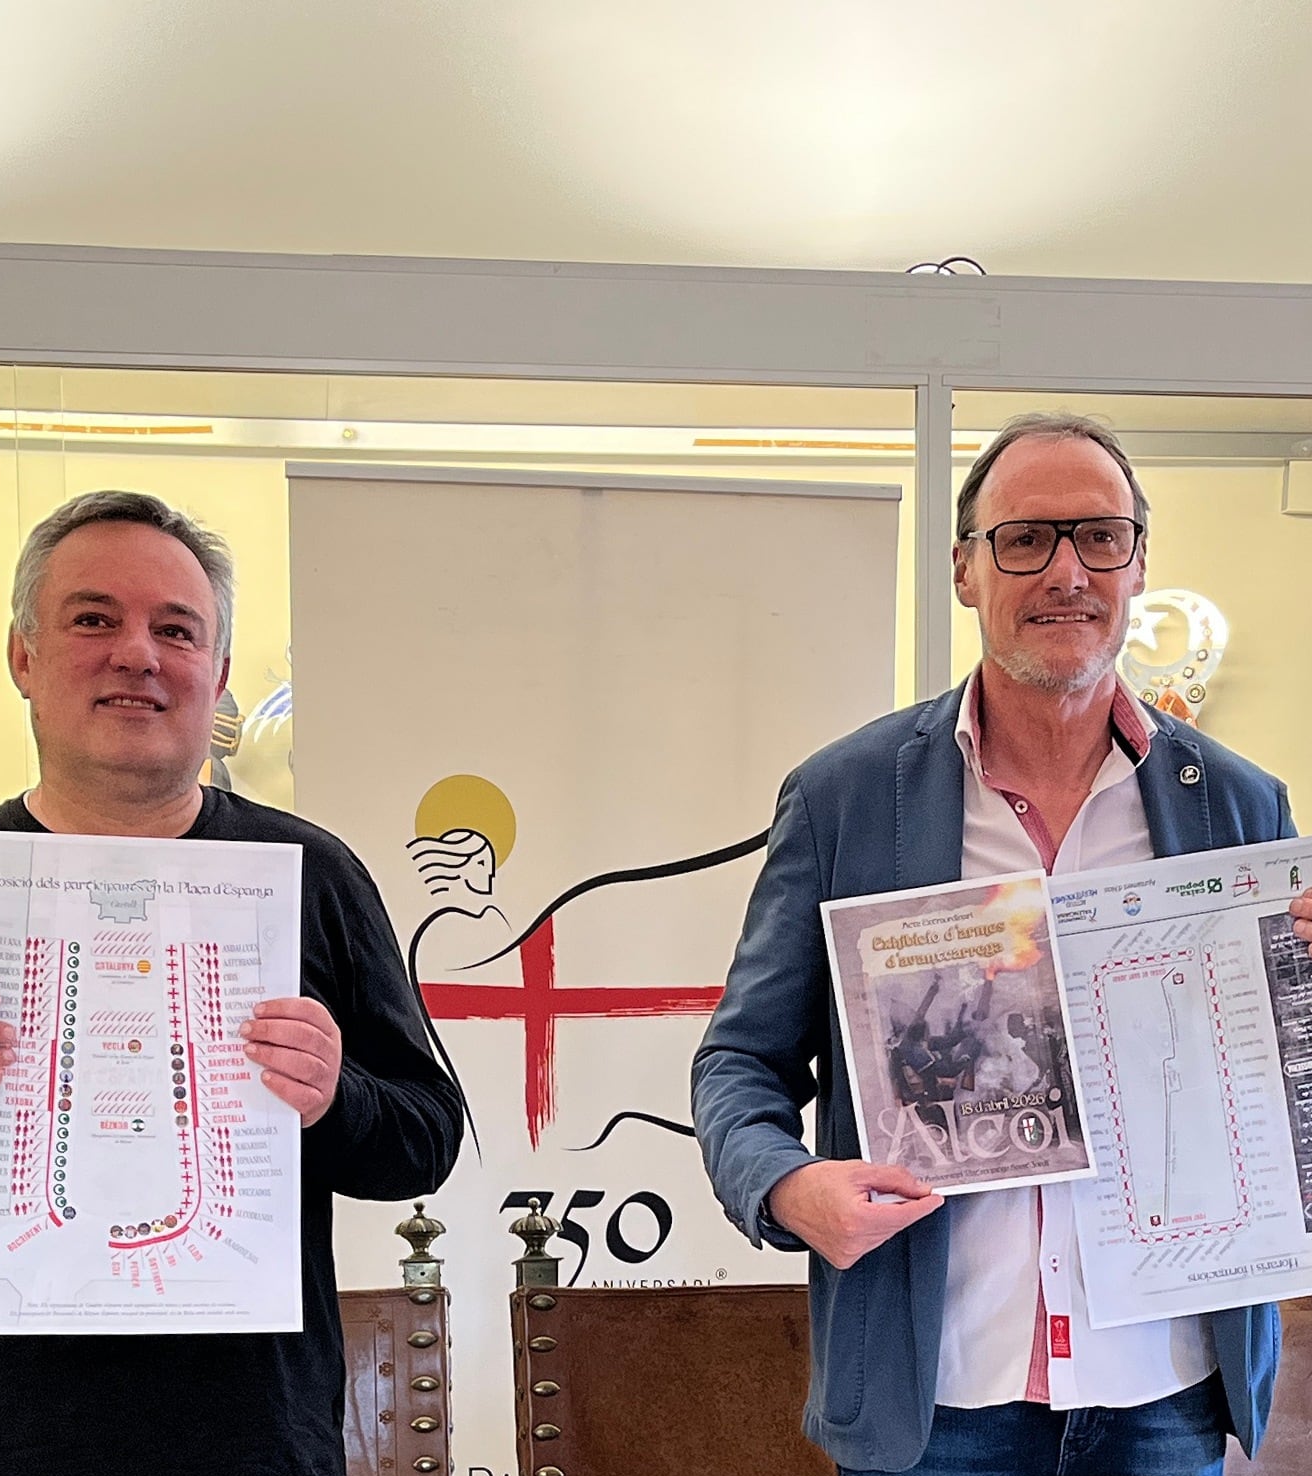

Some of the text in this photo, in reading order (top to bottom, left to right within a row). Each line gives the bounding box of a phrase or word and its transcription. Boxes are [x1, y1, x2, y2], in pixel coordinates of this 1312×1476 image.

[36, 877, 61, 889] dels
[163, 882, 174, 894] la
[213, 882, 274, 898] d'Espanya
[1166, 880, 1205, 895] popular
[1180, 888, 1205, 897] caixa
[902, 921, 921, 929] Acte
[944, 921, 1006, 942] d'armes
[961, 1103, 973, 1116] 18
[1011, 1093, 1046, 1108] 2026
[878, 1087, 1077, 1169] Alcoi
[1256, 1257, 1299, 1274] Horaris
[1187, 1267, 1249, 1282] formacions
